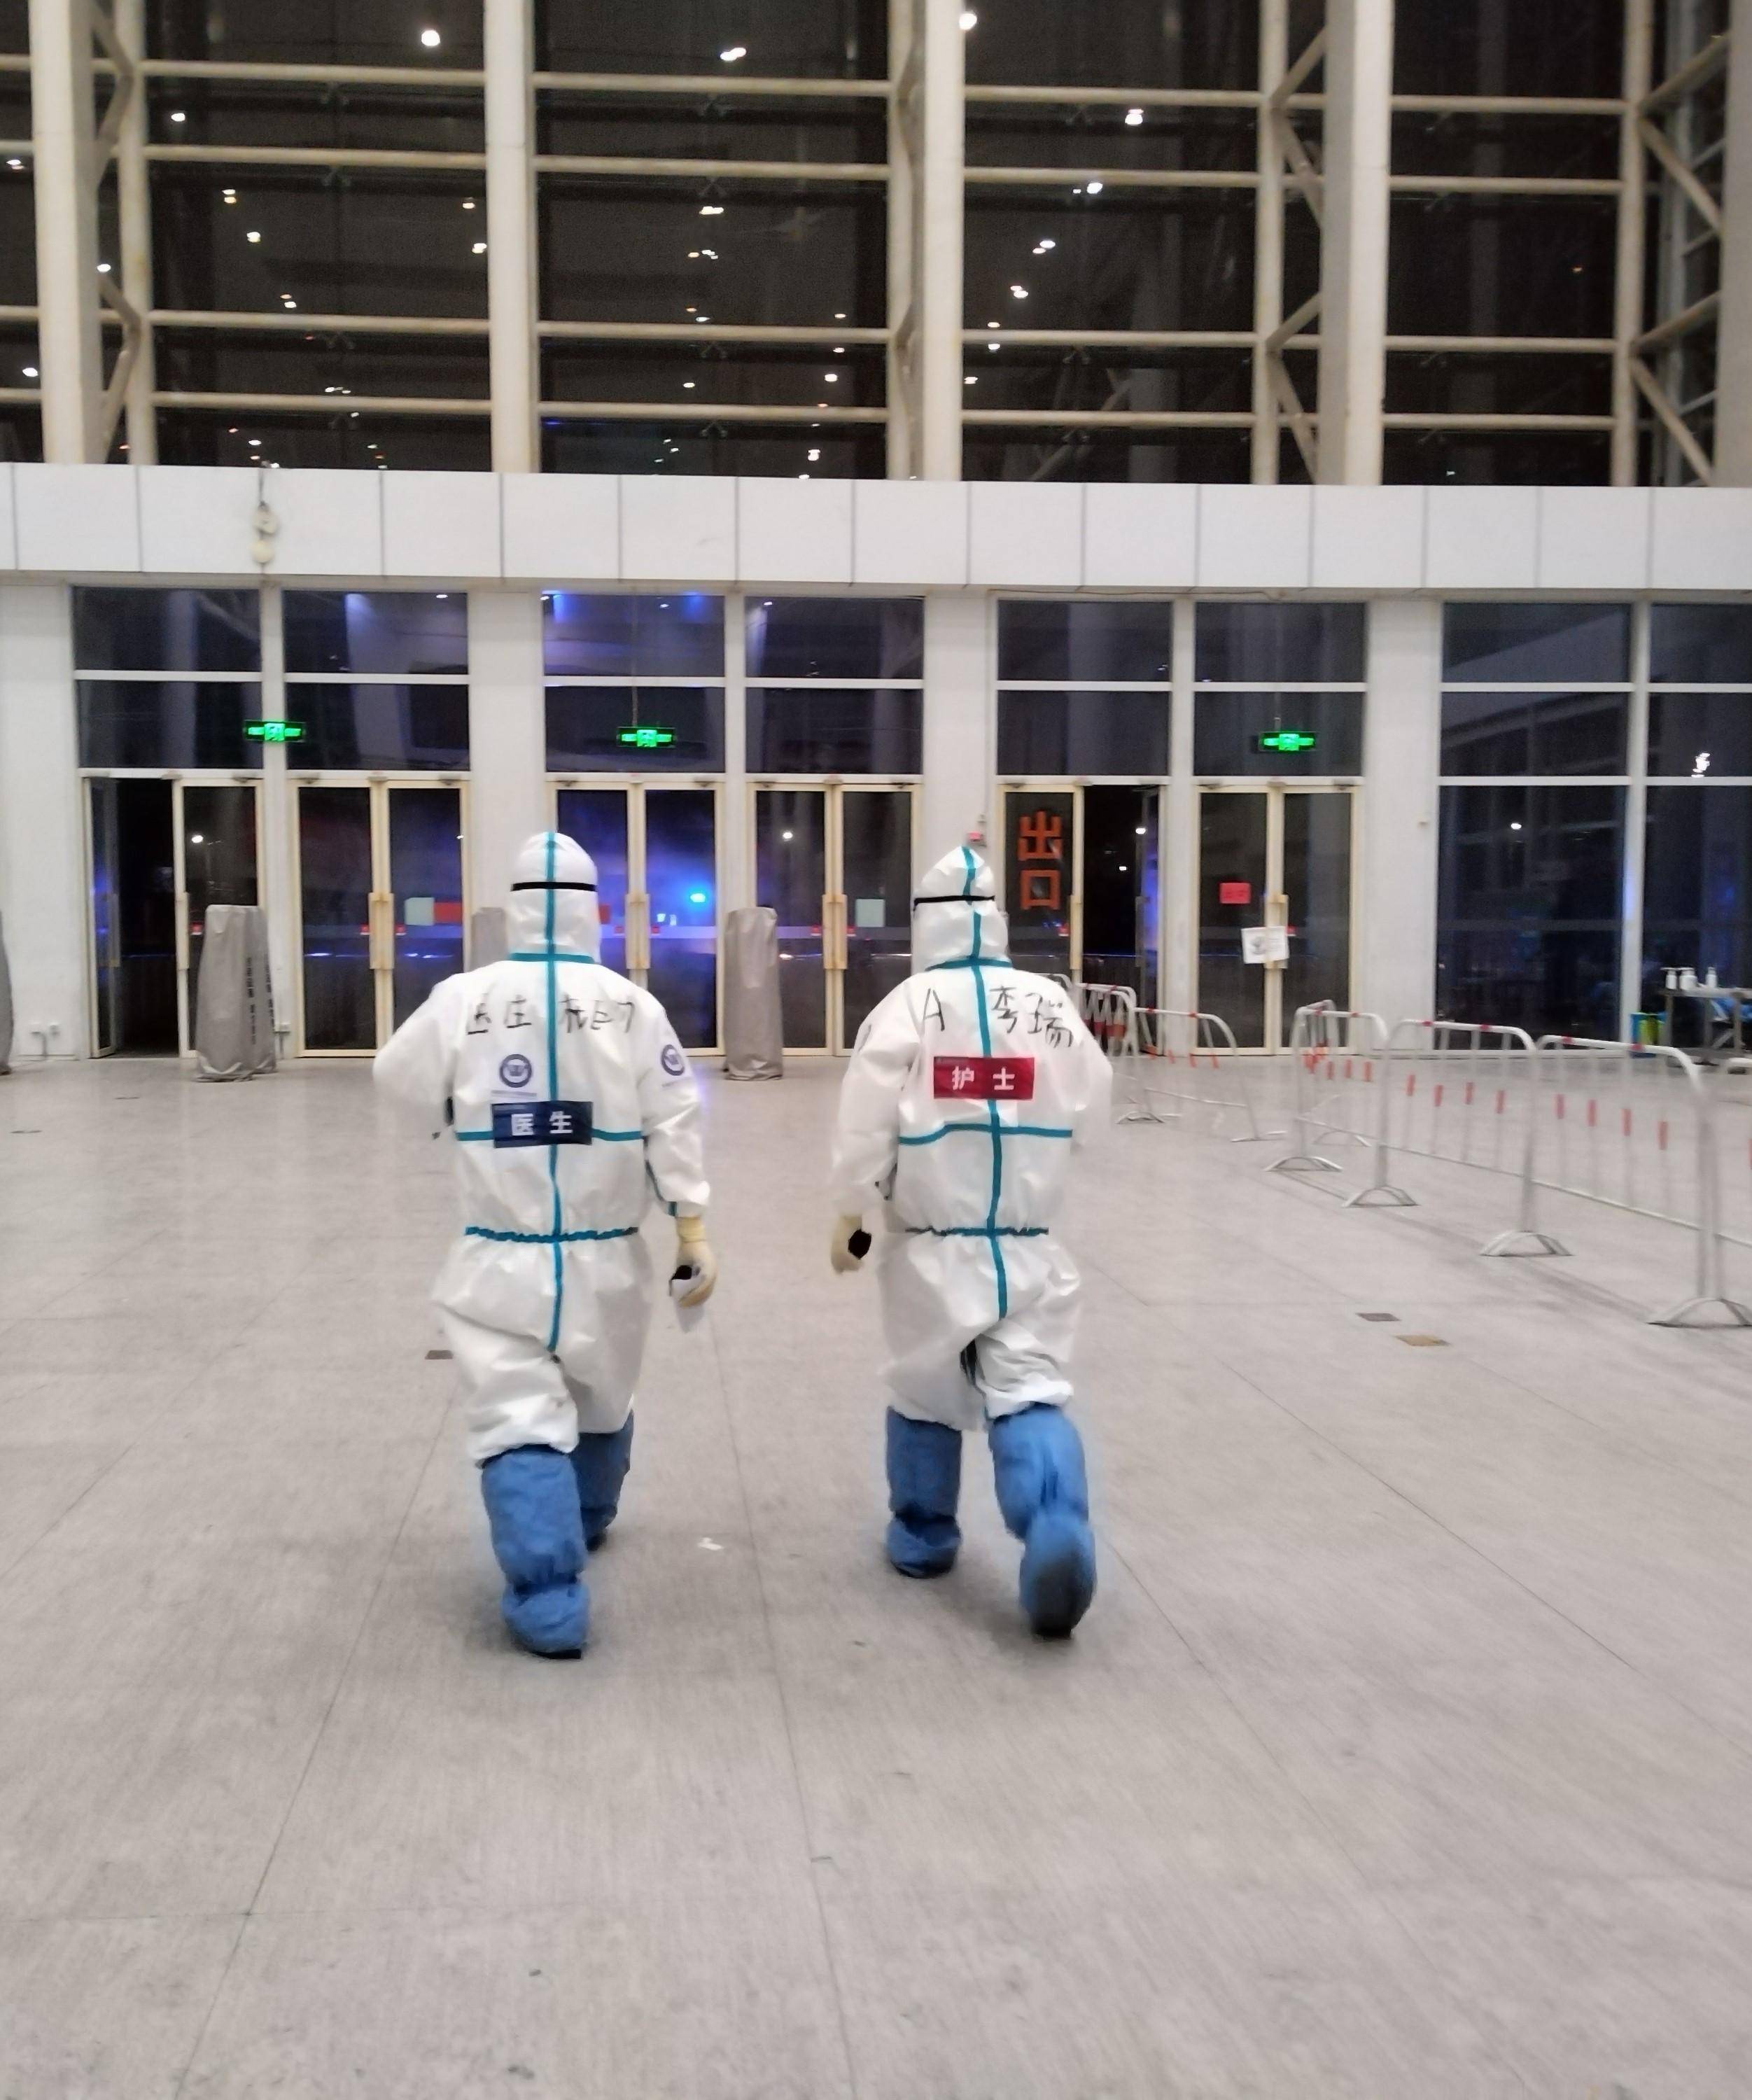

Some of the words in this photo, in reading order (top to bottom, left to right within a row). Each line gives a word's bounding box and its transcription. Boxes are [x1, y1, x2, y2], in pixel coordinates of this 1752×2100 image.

[1018, 811, 1063, 910] 出口
[923, 988, 945, 1032] A
[952, 1066, 1015, 1091] 护士
[511, 1111, 573, 1136] 医生
